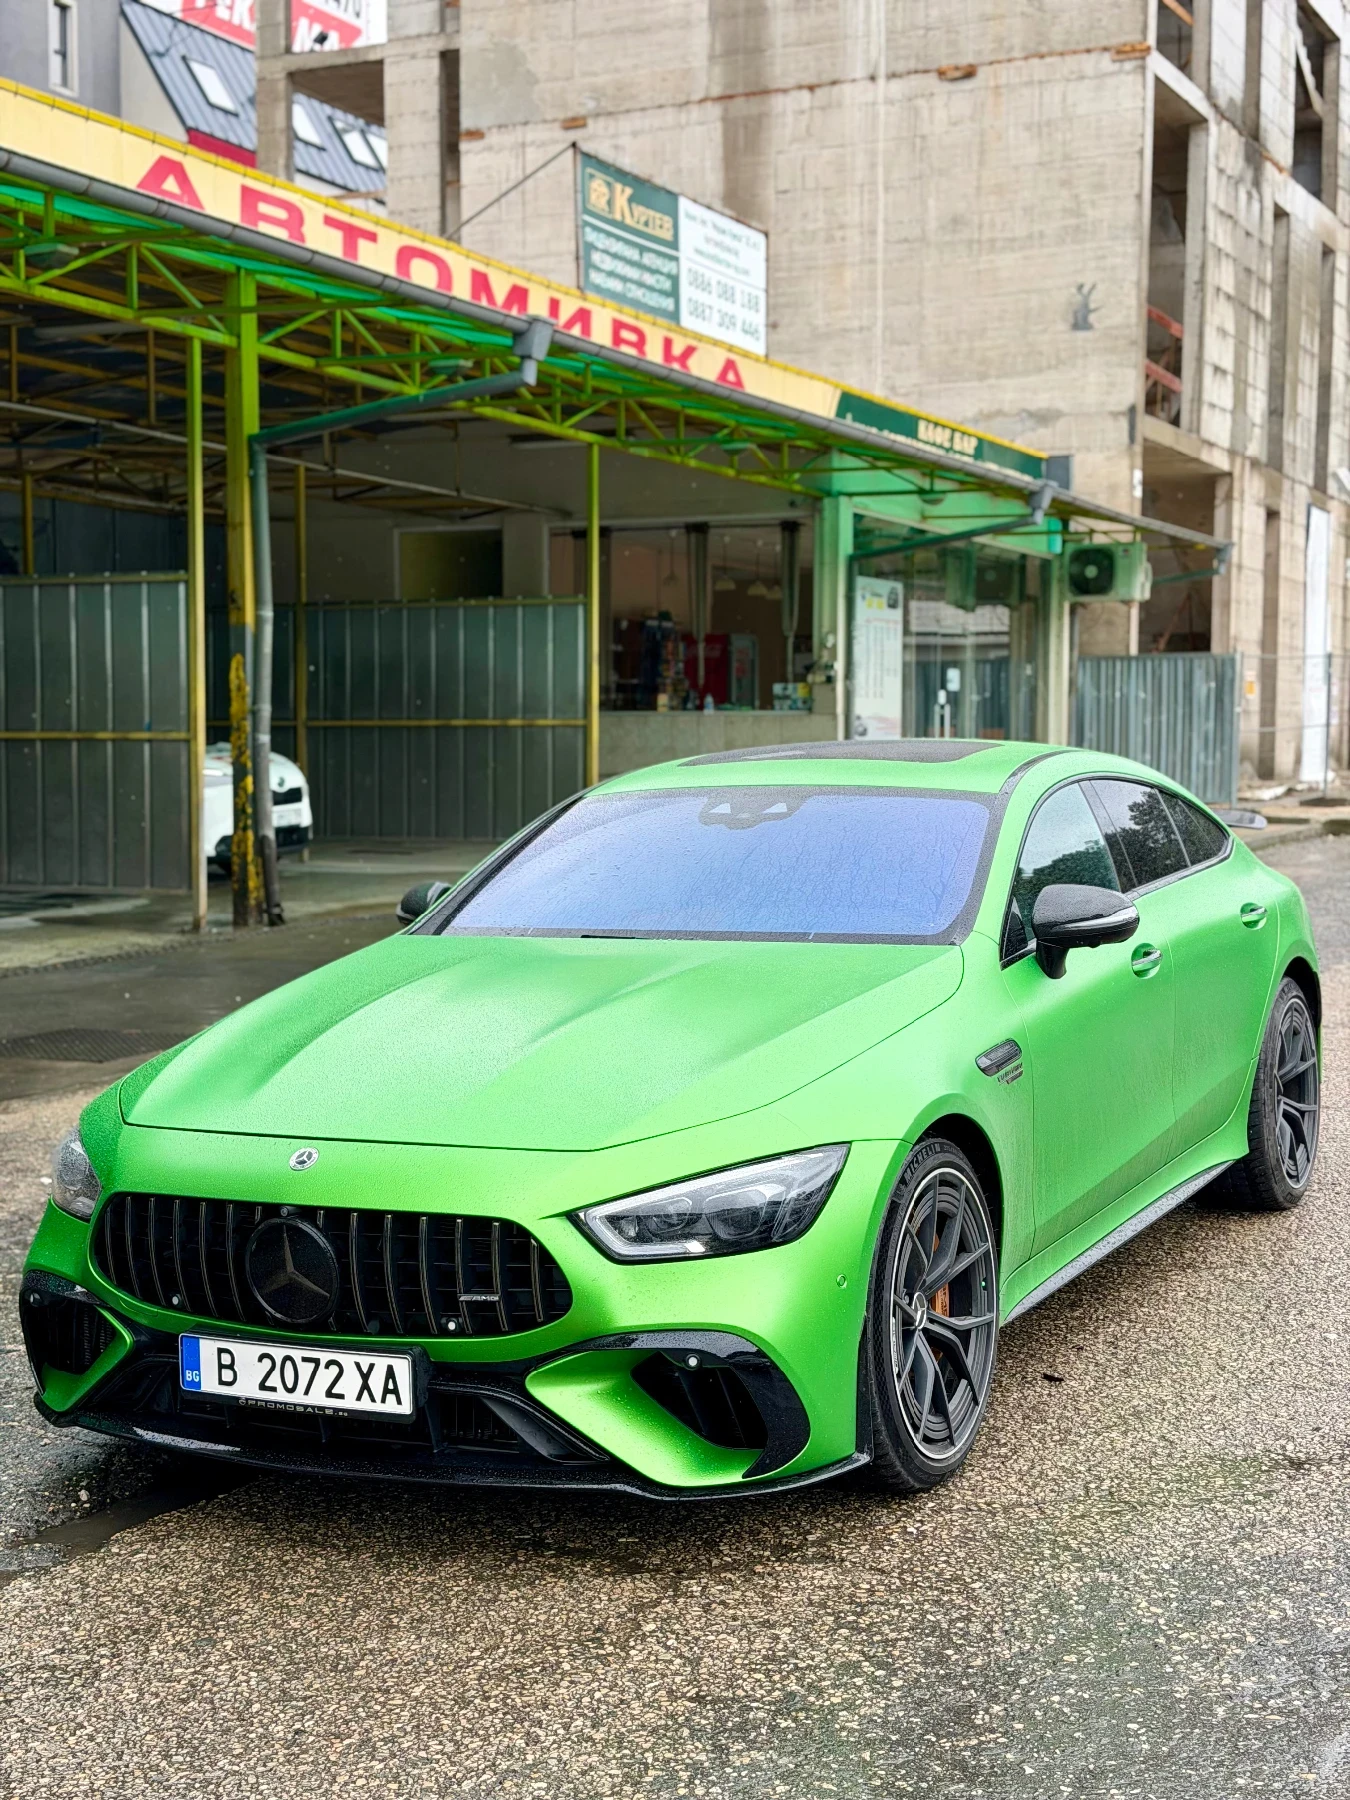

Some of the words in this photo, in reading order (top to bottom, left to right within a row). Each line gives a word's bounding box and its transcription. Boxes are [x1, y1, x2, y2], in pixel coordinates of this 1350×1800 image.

[136, 155, 746, 390] АВТОМИВКА
[904, 1143, 941, 1184] MICHELIN
[185, 1369, 200, 1383] BG
[216, 1347, 239, 1387] B
[257, 1352, 346, 1400] 2072
[353, 1360, 403, 1406] XA
